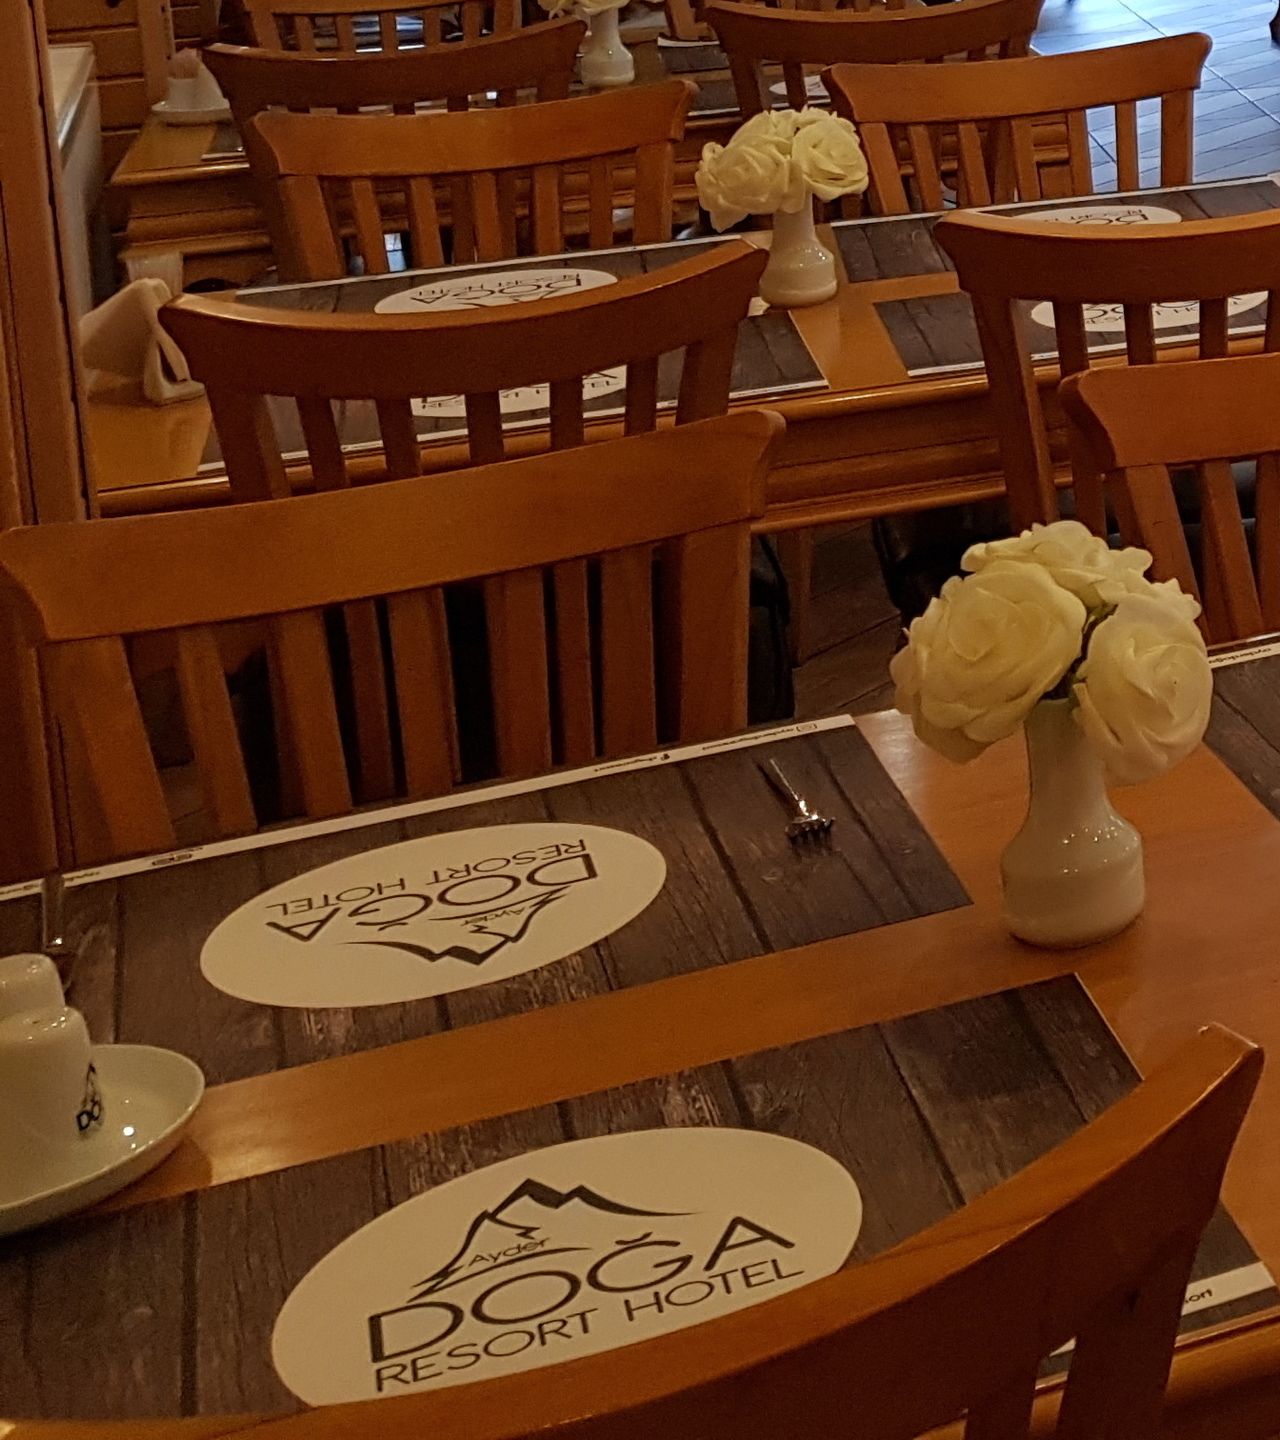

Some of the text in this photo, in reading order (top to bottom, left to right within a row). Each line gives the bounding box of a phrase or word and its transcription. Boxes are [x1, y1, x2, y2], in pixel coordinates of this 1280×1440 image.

[265, 854, 598, 942] DOĞA
[266, 839, 587, 916] RESORT HOTEL
[368, 1216, 795, 1362] DOĞA
[468, 1237, 551, 1267] Ayder
[374, 1258, 804, 1392] RESORT HOTEL
